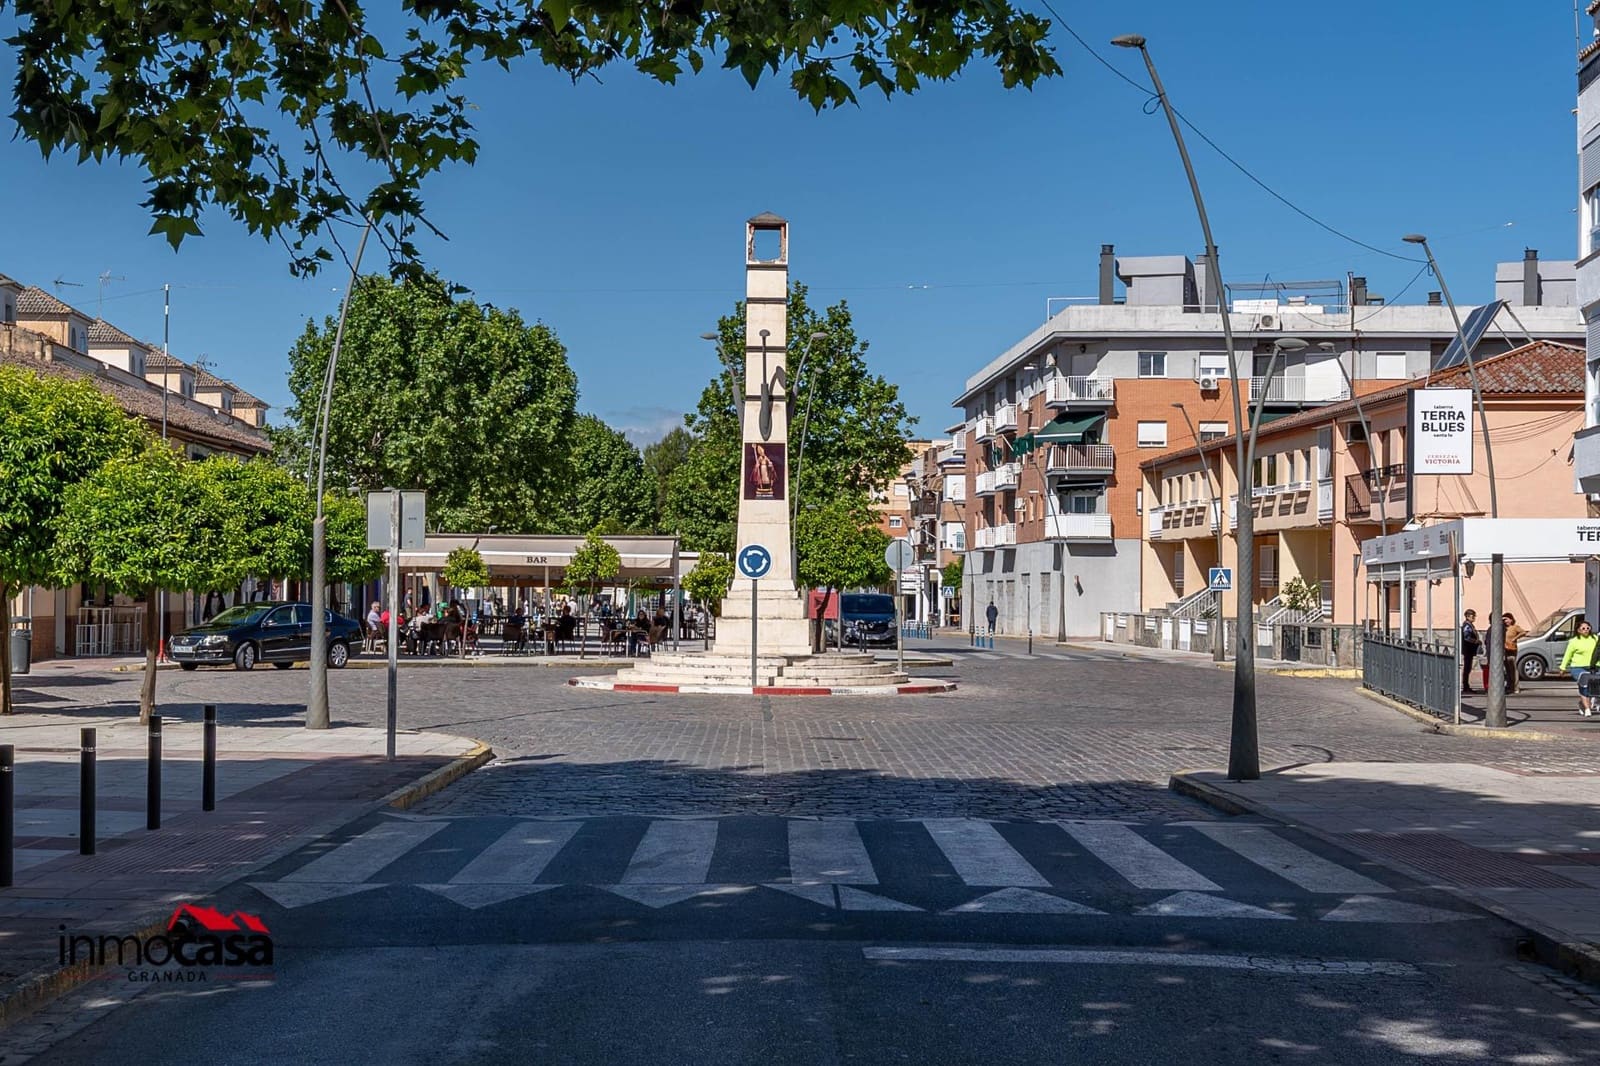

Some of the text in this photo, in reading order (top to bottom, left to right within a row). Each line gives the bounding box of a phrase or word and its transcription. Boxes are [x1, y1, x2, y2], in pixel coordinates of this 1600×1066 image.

[1420, 410, 1466, 421] TERRA
[1421, 422, 1465, 432] BLUES
[526, 556, 547, 564] BAR
